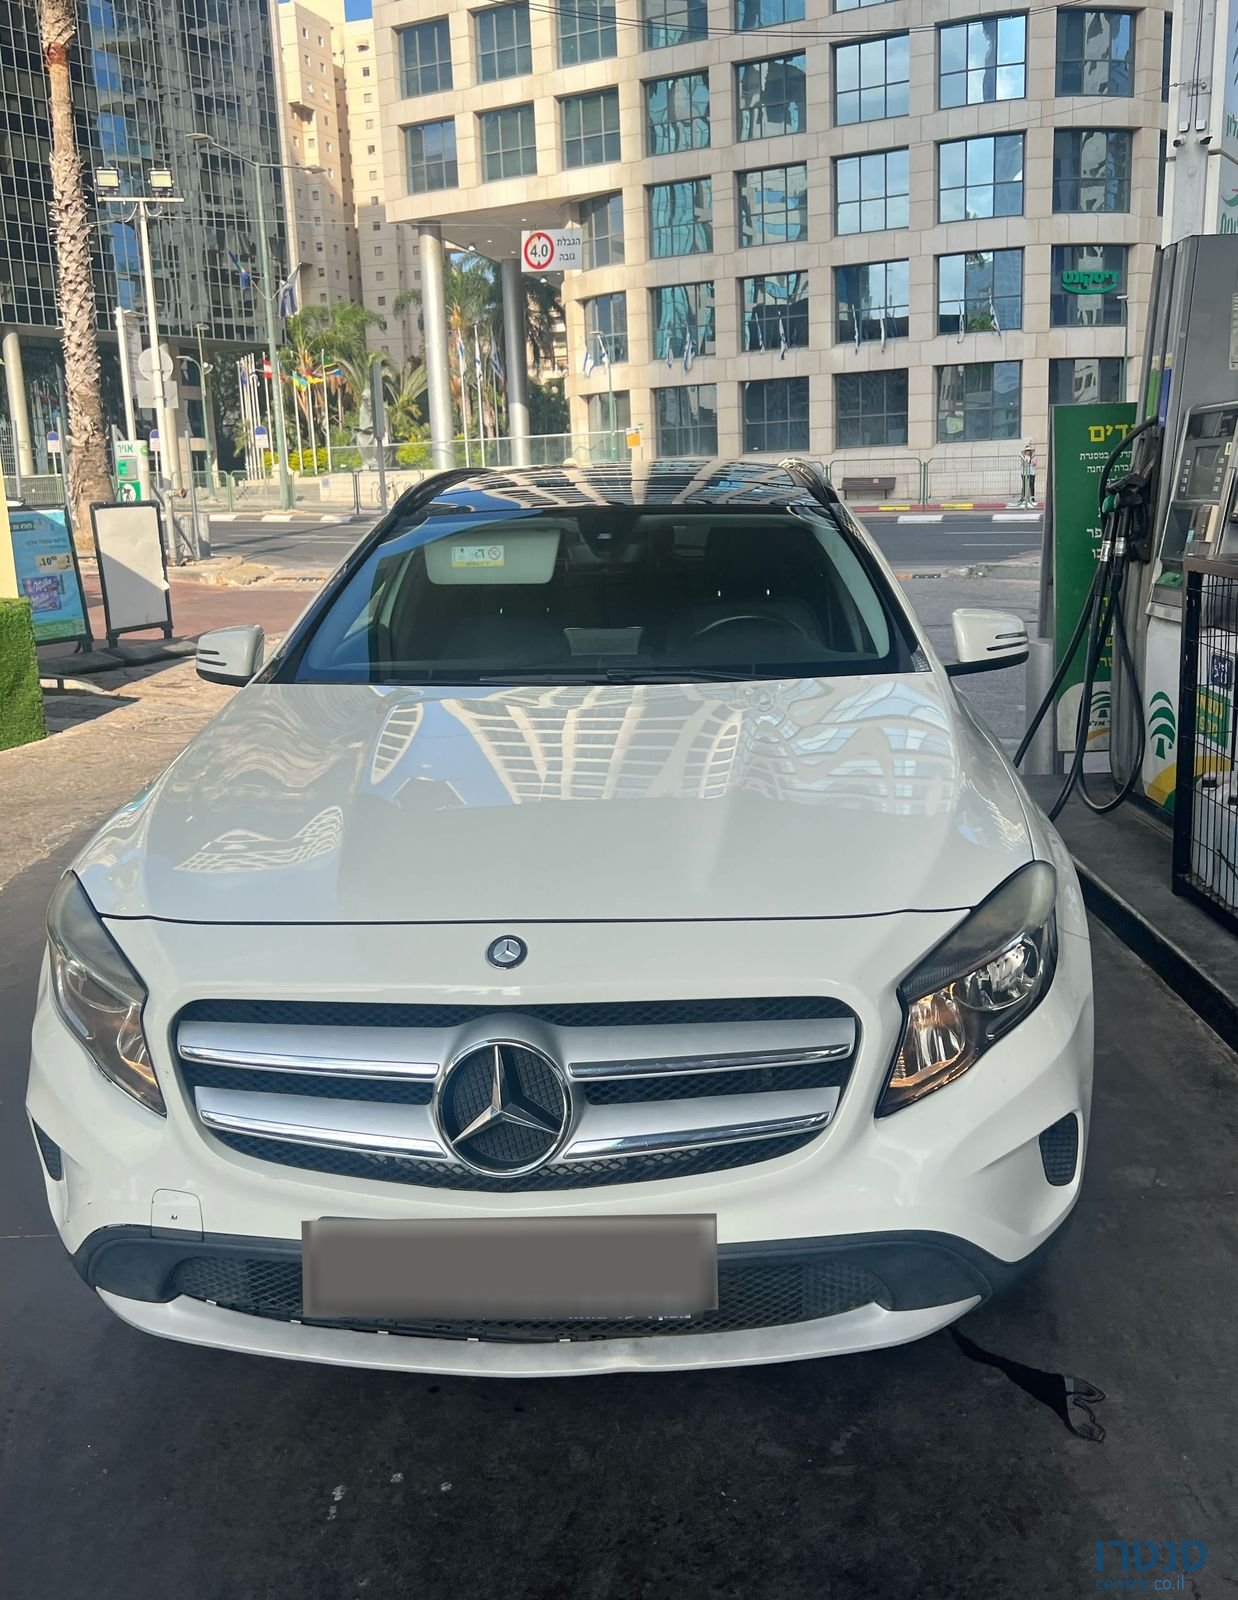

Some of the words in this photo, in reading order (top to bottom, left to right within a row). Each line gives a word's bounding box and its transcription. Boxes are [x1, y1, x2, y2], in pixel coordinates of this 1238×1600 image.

[557, 237, 580, 246] הגבלת
[530, 245, 548, 257] 4.0
[559, 253, 576, 261] גובה
[1062, 271, 1119, 287] דיסקונט
[1088, 424, 1136, 442] דים
[1079, 451, 1110, 461] במסגרת
